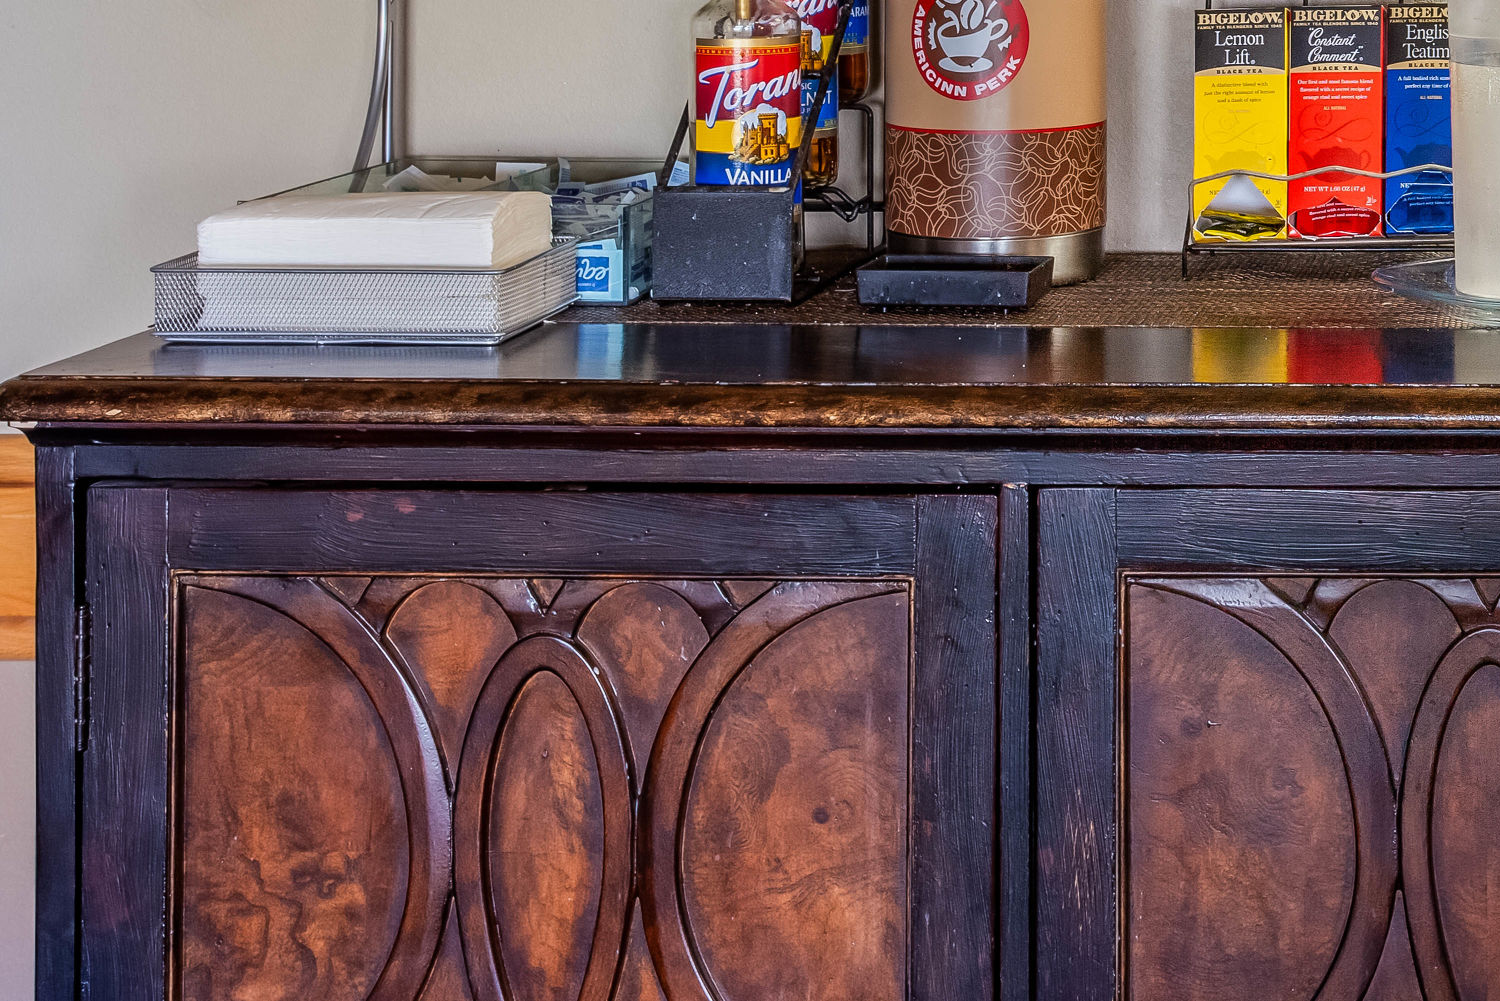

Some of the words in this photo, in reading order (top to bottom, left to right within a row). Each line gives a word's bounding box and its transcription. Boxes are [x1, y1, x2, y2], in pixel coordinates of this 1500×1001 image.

[1197, 11, 1282, 25] BIGELOW
[1293, 9, 1379, 21] BIGELOW
[1389, 7, 1448, 19] BIGEL
[1214, 31, 1264, 46] Lemon
[1406, 24, 1449, 42] Englis
[913, 4, 968, 98] AMERICINN
[974, 55, 1021, 97] PERK
[1224, 48, 1251, 65] Lift
[1402, 42, 1450, 59] Teatim
[725, 168, 792, 185] VANILLA
